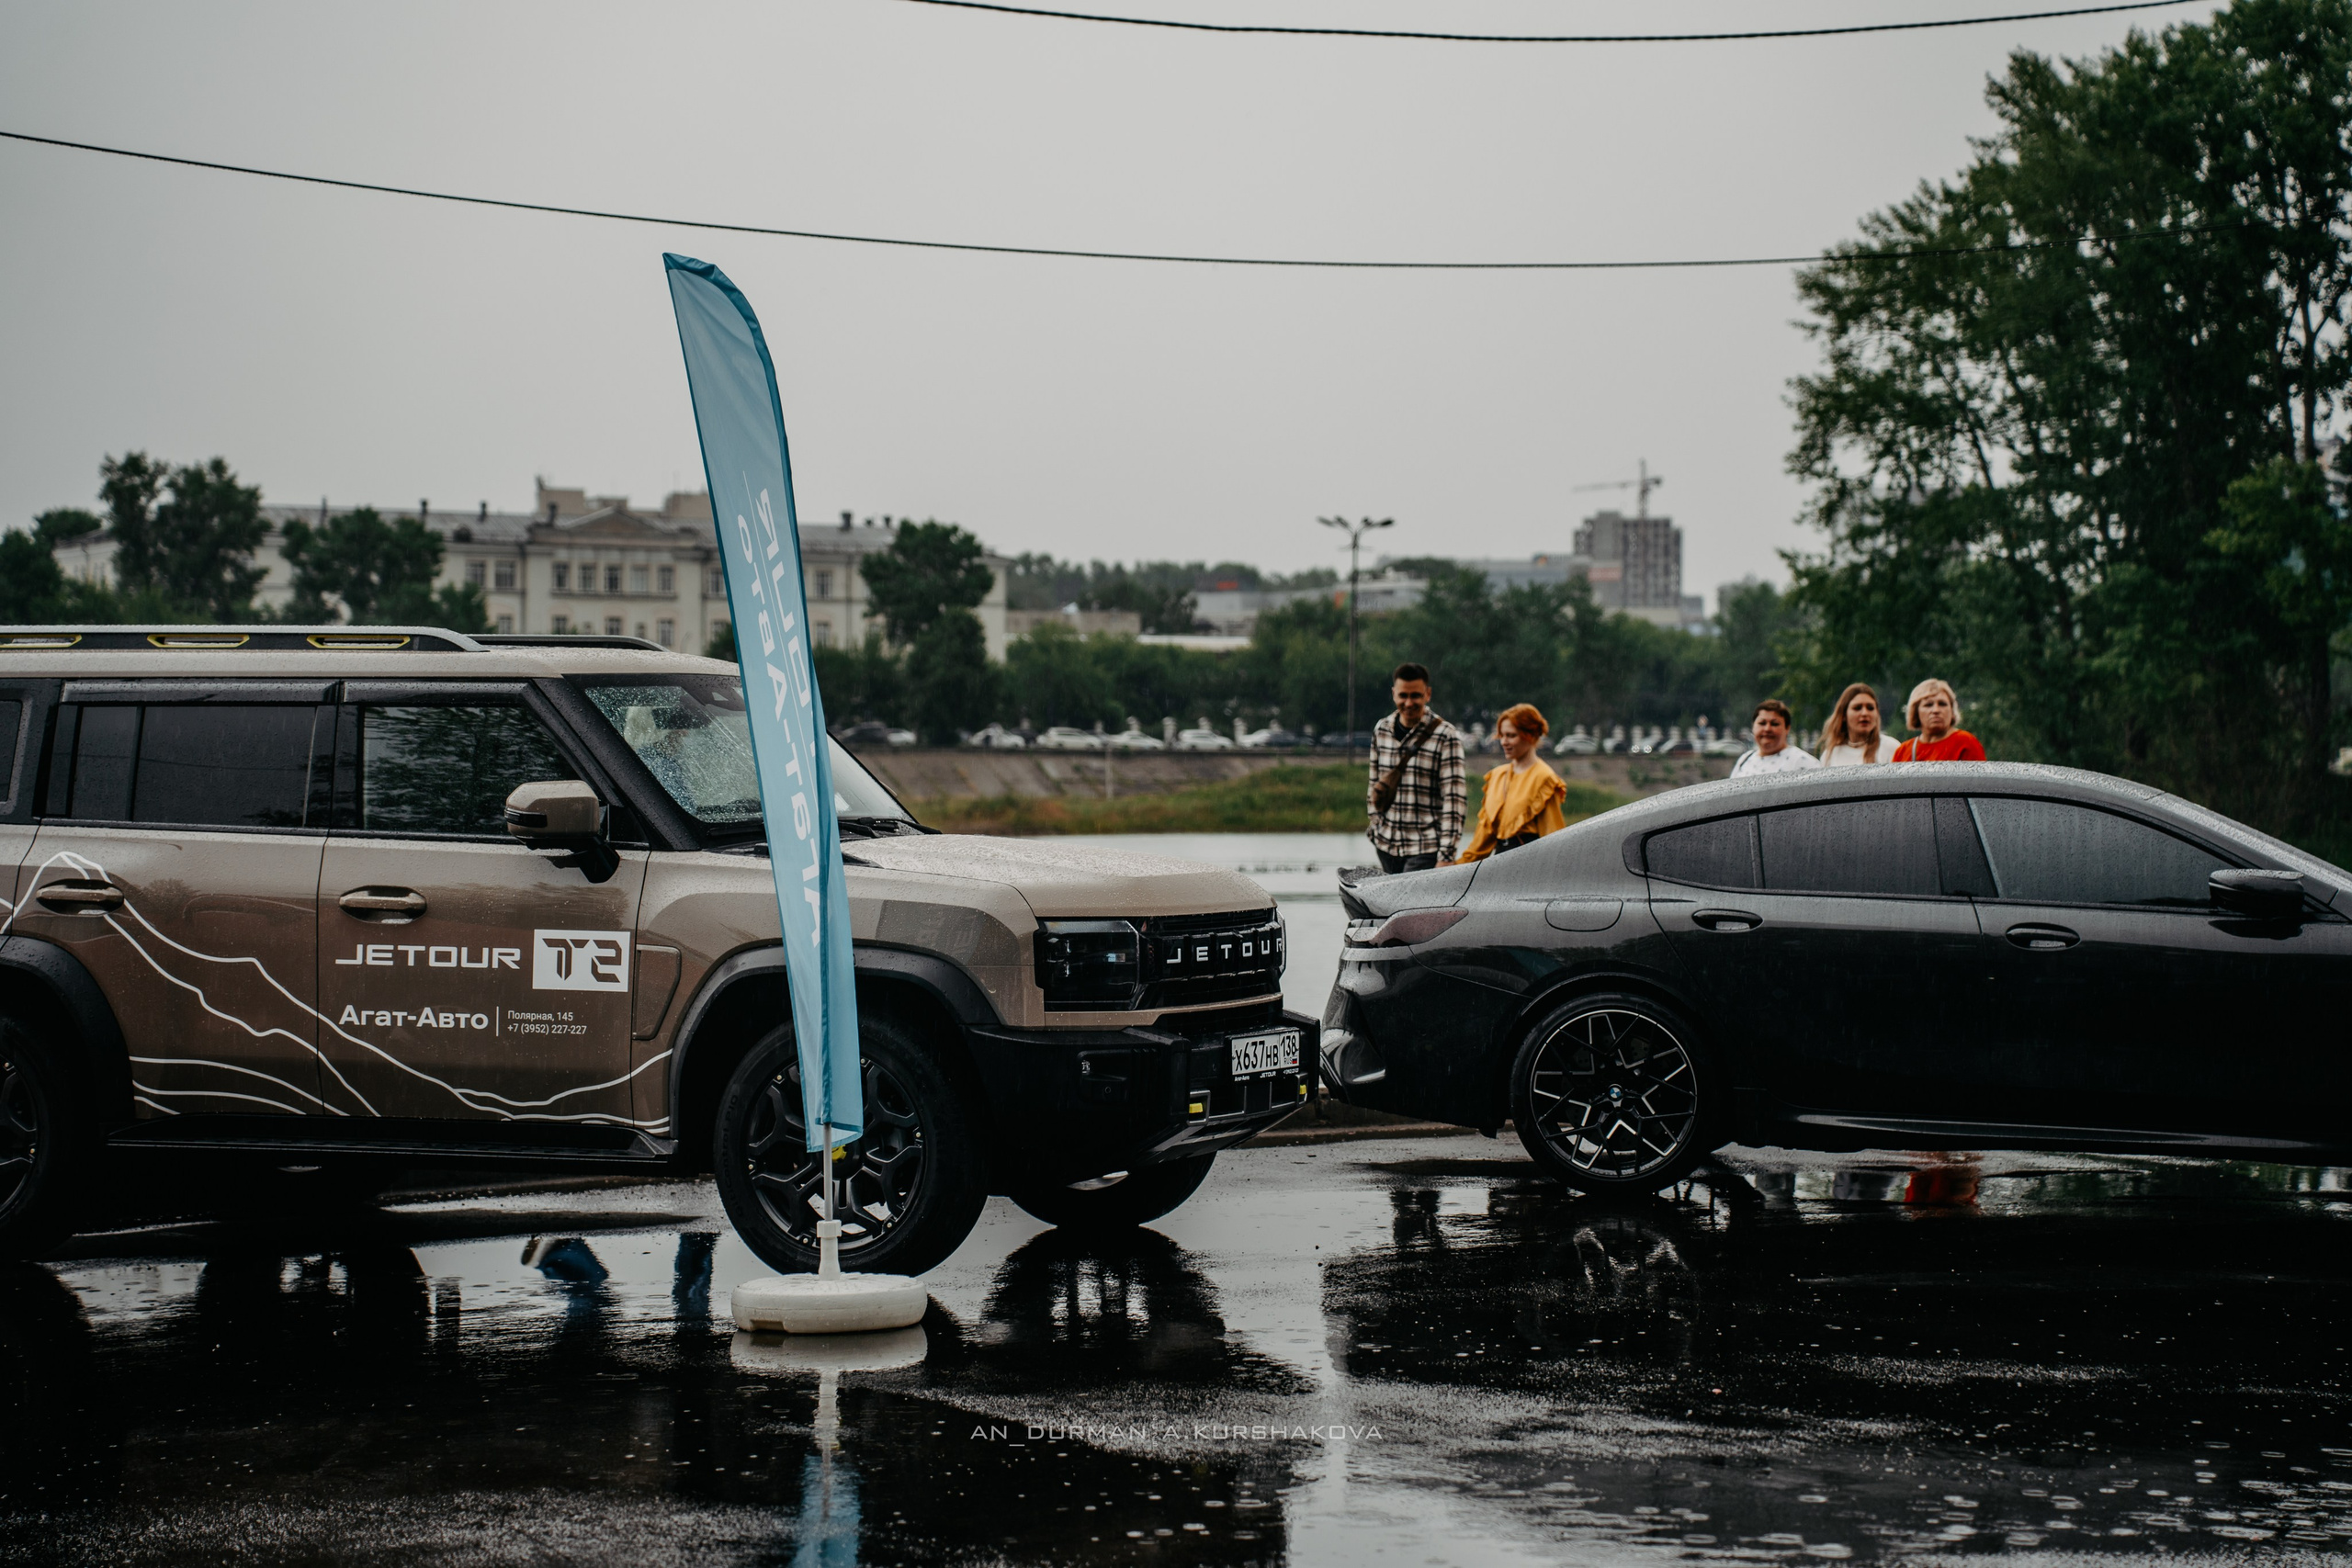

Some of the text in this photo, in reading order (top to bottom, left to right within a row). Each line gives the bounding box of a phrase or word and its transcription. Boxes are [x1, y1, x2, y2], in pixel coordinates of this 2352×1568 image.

[335, 943, 520, 969] JETOUR
[1166, 937, 1282, 964] JETOUR
[339, 1004, 489, 1030] Агат-Авто
[507, 1010, 573, 1021] Полярная, 145
[507, 1022, 587, 1035] +7 (3952) 227-227
